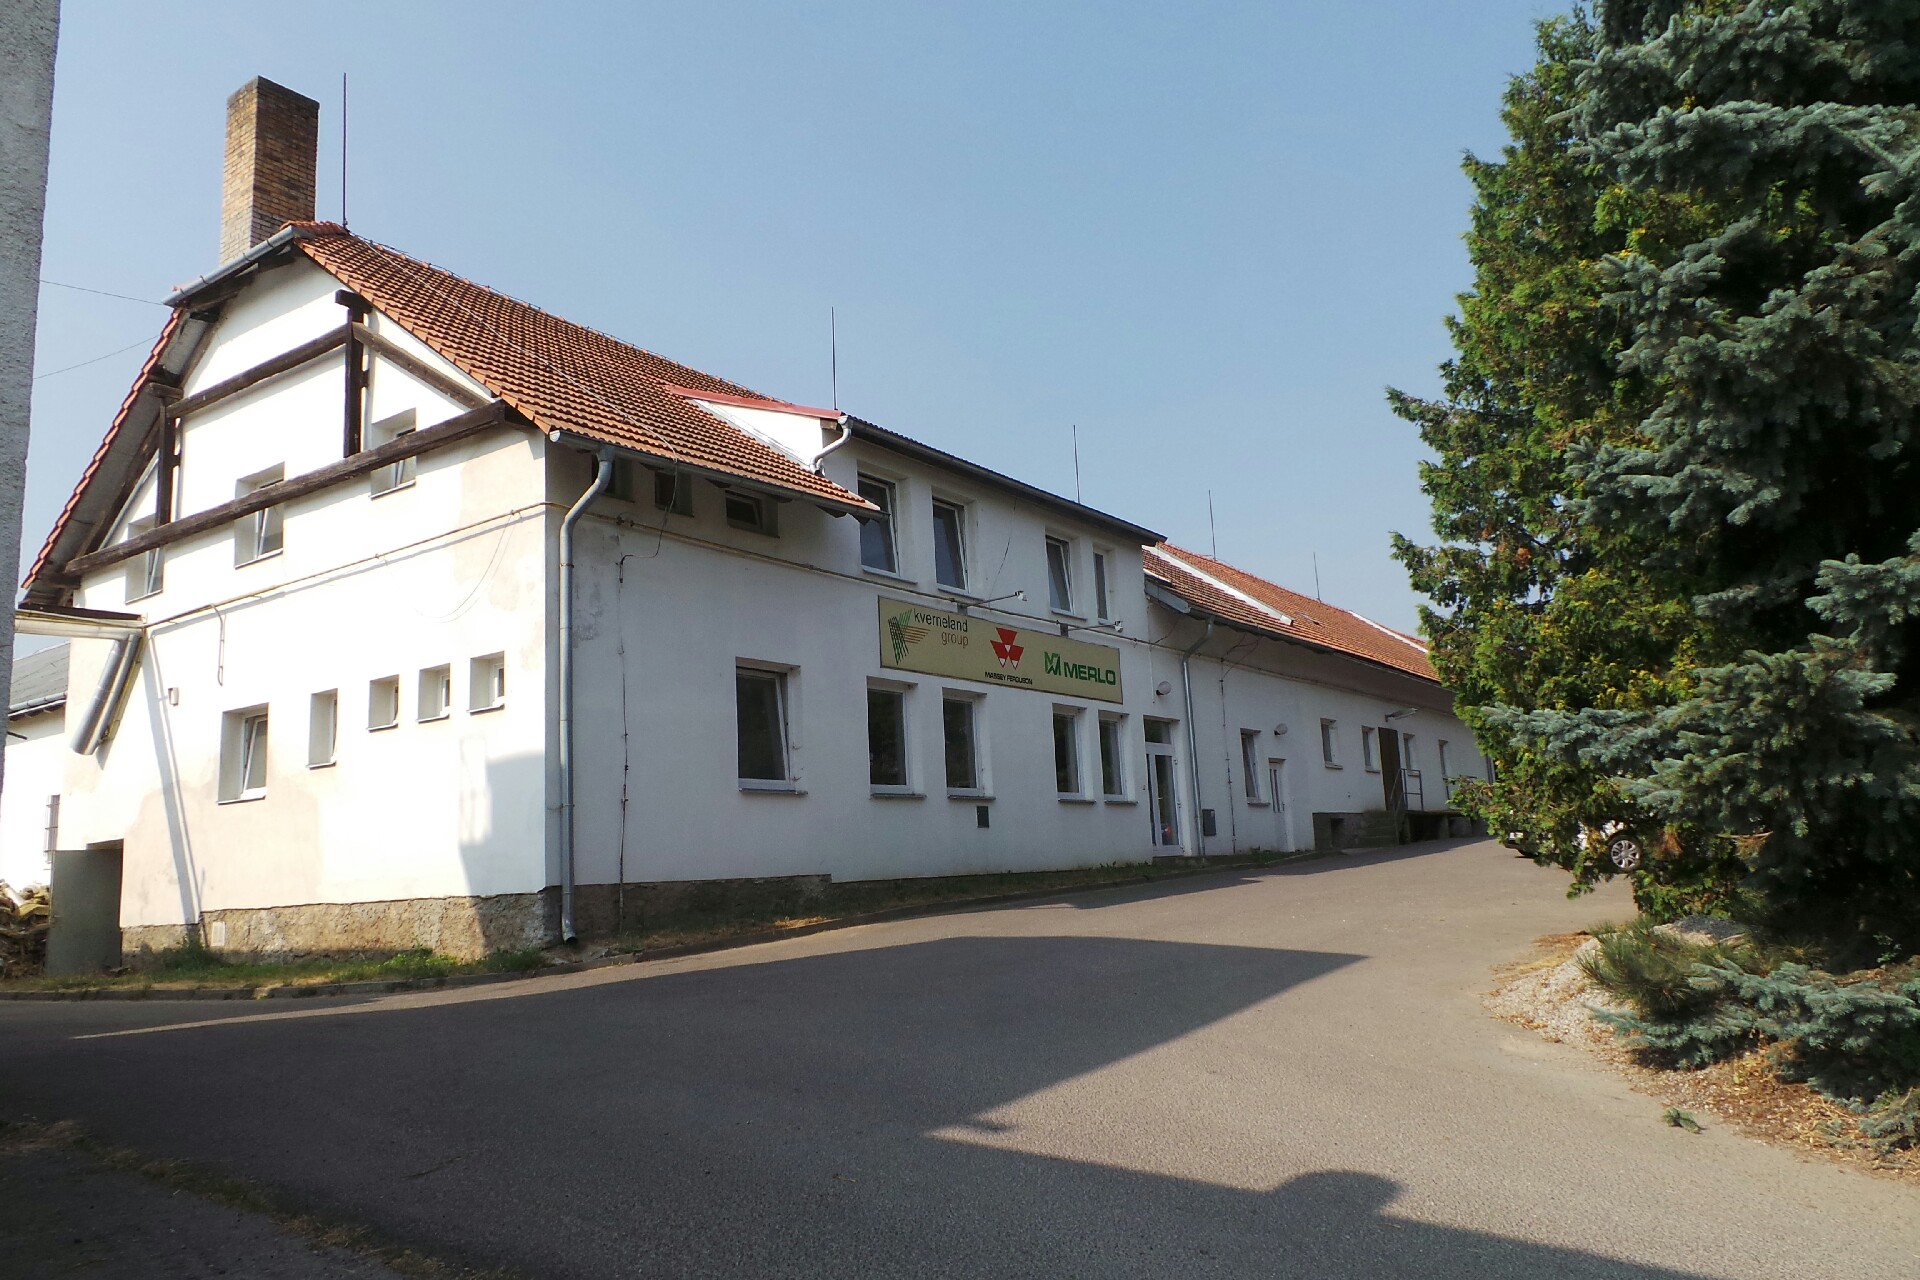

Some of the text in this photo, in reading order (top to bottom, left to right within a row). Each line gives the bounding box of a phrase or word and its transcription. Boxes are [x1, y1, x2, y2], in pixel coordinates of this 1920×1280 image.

[913, 609, 968, 633] kverneland
[941, 632, 969, 648] group
[984, 671, 1033, 685] MASSEY FERGUSON
[1064, 662, 1116, 686] MERLO
